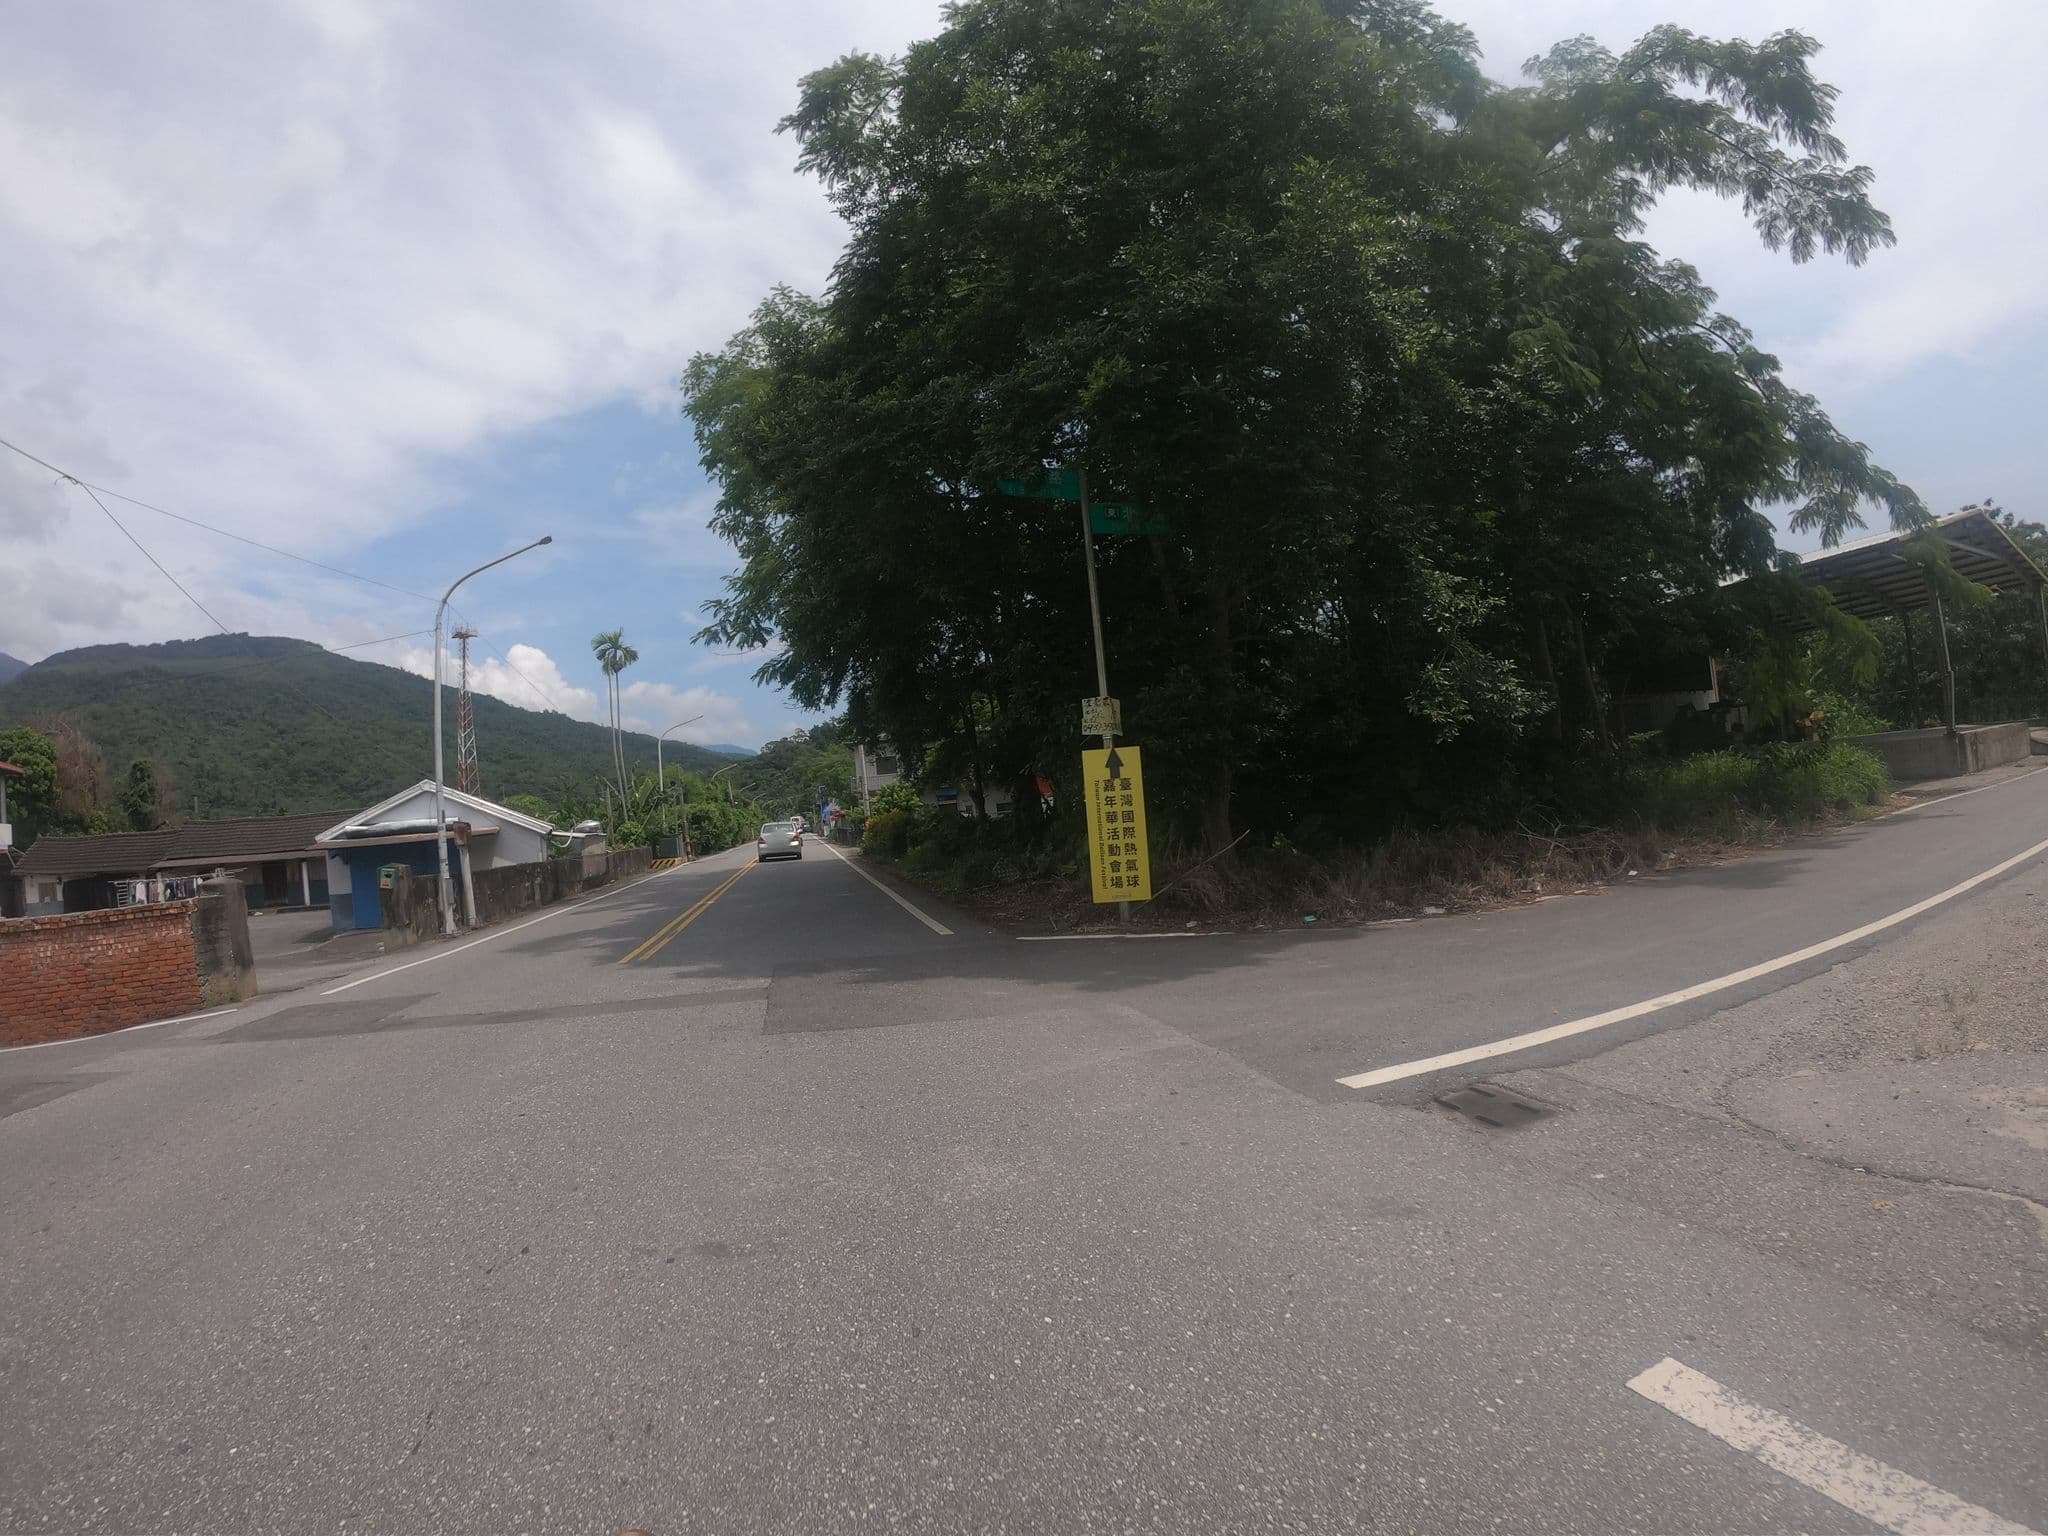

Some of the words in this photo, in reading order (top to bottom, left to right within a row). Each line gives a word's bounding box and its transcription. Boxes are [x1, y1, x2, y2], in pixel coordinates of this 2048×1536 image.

[1103, 779, 1124, 889] 嘉年華活動會場
[1119, 777, 1140, 888] 臺灣國際熱氣球
